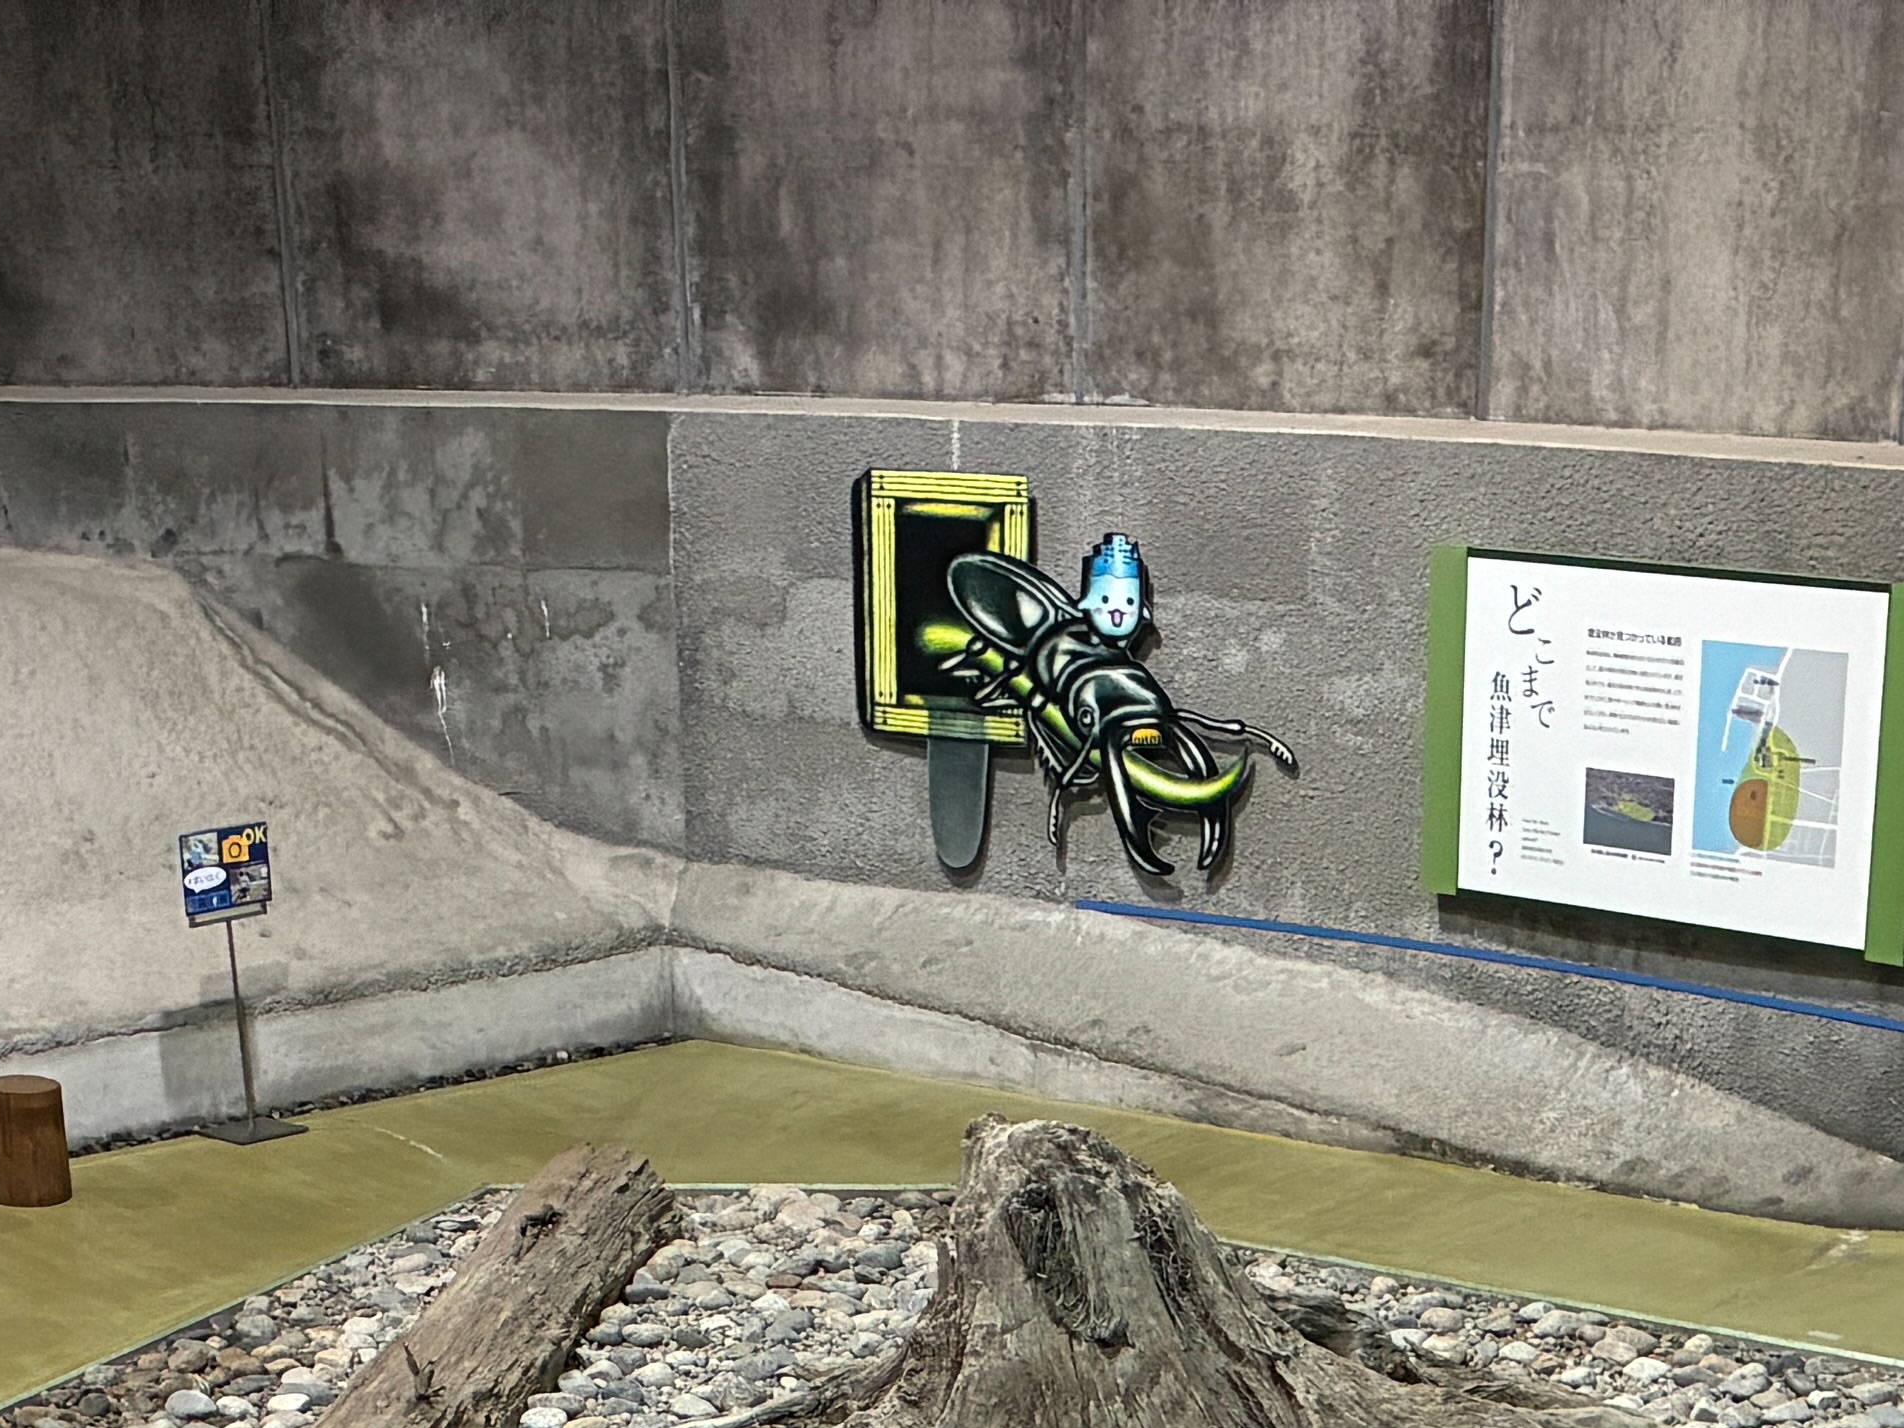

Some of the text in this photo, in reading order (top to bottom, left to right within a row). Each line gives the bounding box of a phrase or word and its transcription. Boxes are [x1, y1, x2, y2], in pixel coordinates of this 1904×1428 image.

[1507, 583, 1556, 729] どこまで
[1485, 670, 1513, 876] 魚津埋没林？
